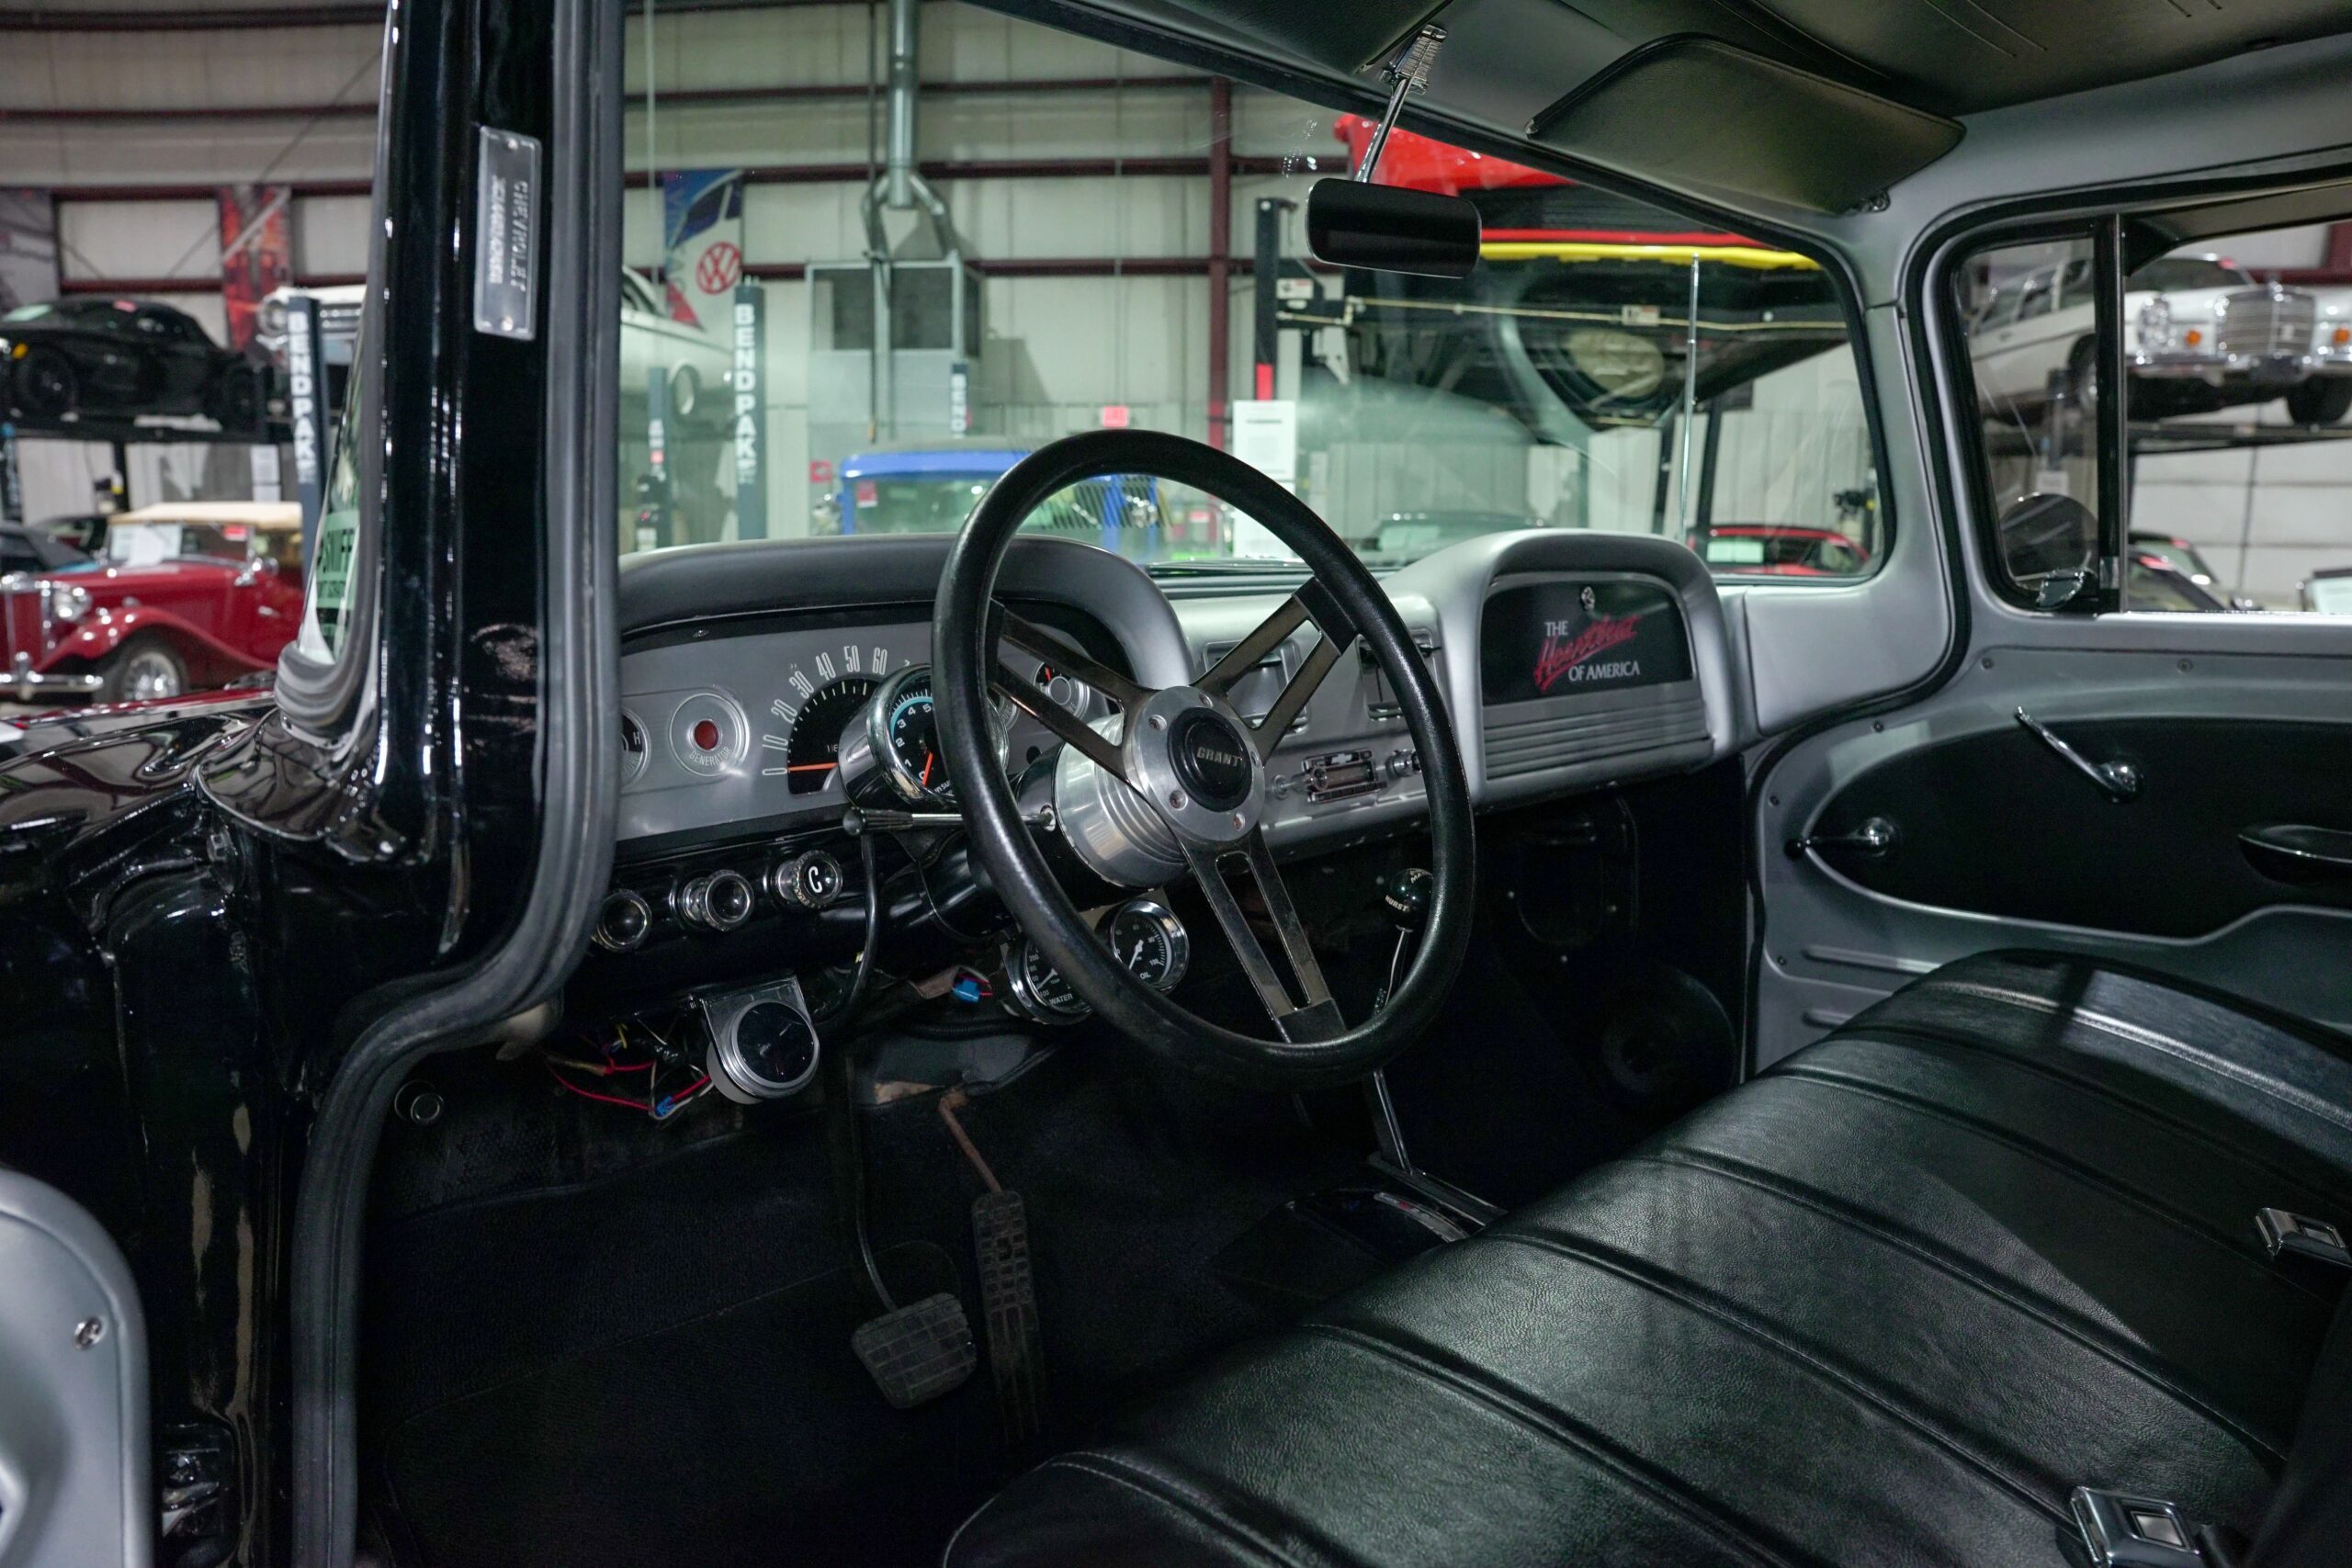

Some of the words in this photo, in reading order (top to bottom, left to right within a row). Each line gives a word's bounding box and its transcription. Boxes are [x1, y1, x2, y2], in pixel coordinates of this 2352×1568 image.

[511, 181, 529, 293] CHEVROLET
[288, 311, 315, 459] BENDPAK
[734, 304, 757, 458] BENDPAK
[1544, 620, 1569, 637] THE
[816, 651, 836, 681] 40
[843, 645, 861, 673] 50
[872, 647, 888, 675] 60
[1568, 665, 1585, 682] OF
[1587, 660, 1641, 681] AMERICA
[789, 671, 814, 700] 30
[771, 699, 798, 724] 20
[908, 706, 916, 716] 4
[922, 704, 932, 713] 5
[897, 718, 907, 728] 3
[633, 731, 641, 745] H
[762, 734, 788, 751] 10
[896, 738, 905, 748] 2
[689, 746, 732, 766] GENERATOR
[904, 759, 911, 768] 1
[1196, 746, 1239, 767] GRANT
[808, 865, 823, 894] C
[1385, 895, 1408, 912] HURST
[1139, 971, 1152, 980] OIL
[1049, 993, 1073, 1004] WATER
